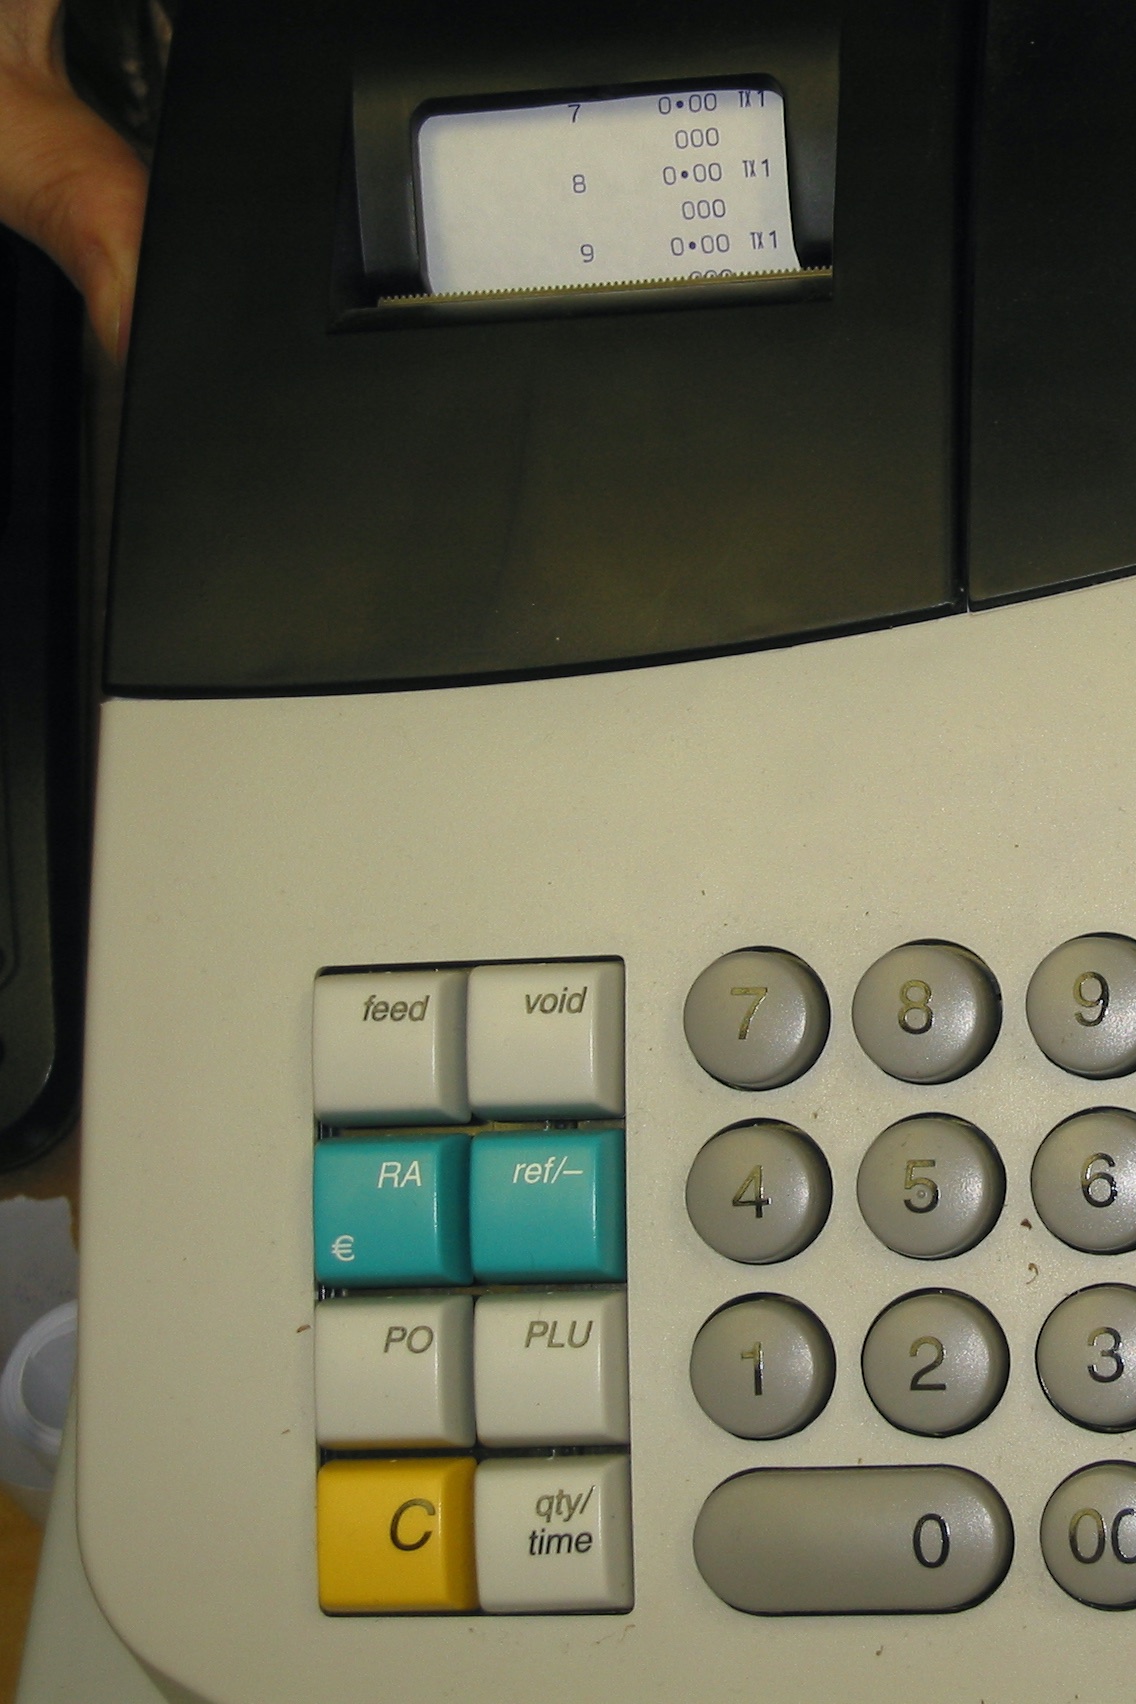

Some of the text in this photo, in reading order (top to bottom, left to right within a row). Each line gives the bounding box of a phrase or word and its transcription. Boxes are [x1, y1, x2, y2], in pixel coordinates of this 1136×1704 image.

[568, 104, 581, 123] 7
[675, 127, 719, 149] 000
[572, 174, 586, 193] 8
[681, 198, 726, 220] 000
[580, 243, 594, 263] 9
[362, 995, 430, 1022] feed
[525, 986, 588, 1014] void
[730, 985, 769, 1040] 7
[898, 979, 934, 1035] 8
[1072, 971, 1110, 1027] 9
[377, 1160, 422, 1188] RA
[731, 1164, 771, 1218] 4
[903, 1159, 940, 1213] 5
[1081, 1152, 1118, 1208] 6
[384, 1325, 434, 1354] PO
[524, 1320, 593, 1348] PLU
[740, 1341, 764, 1396] 1
[909, 1335, 947, 1391] 2
[1087, 1326, 1125, 1383] 3
[535, 1485, 596, 1522] qty/
[390, 1498, 435, 1551] C
[528, 1528, 592, 1556] time
[912, 1512, 950, 1568] 0
